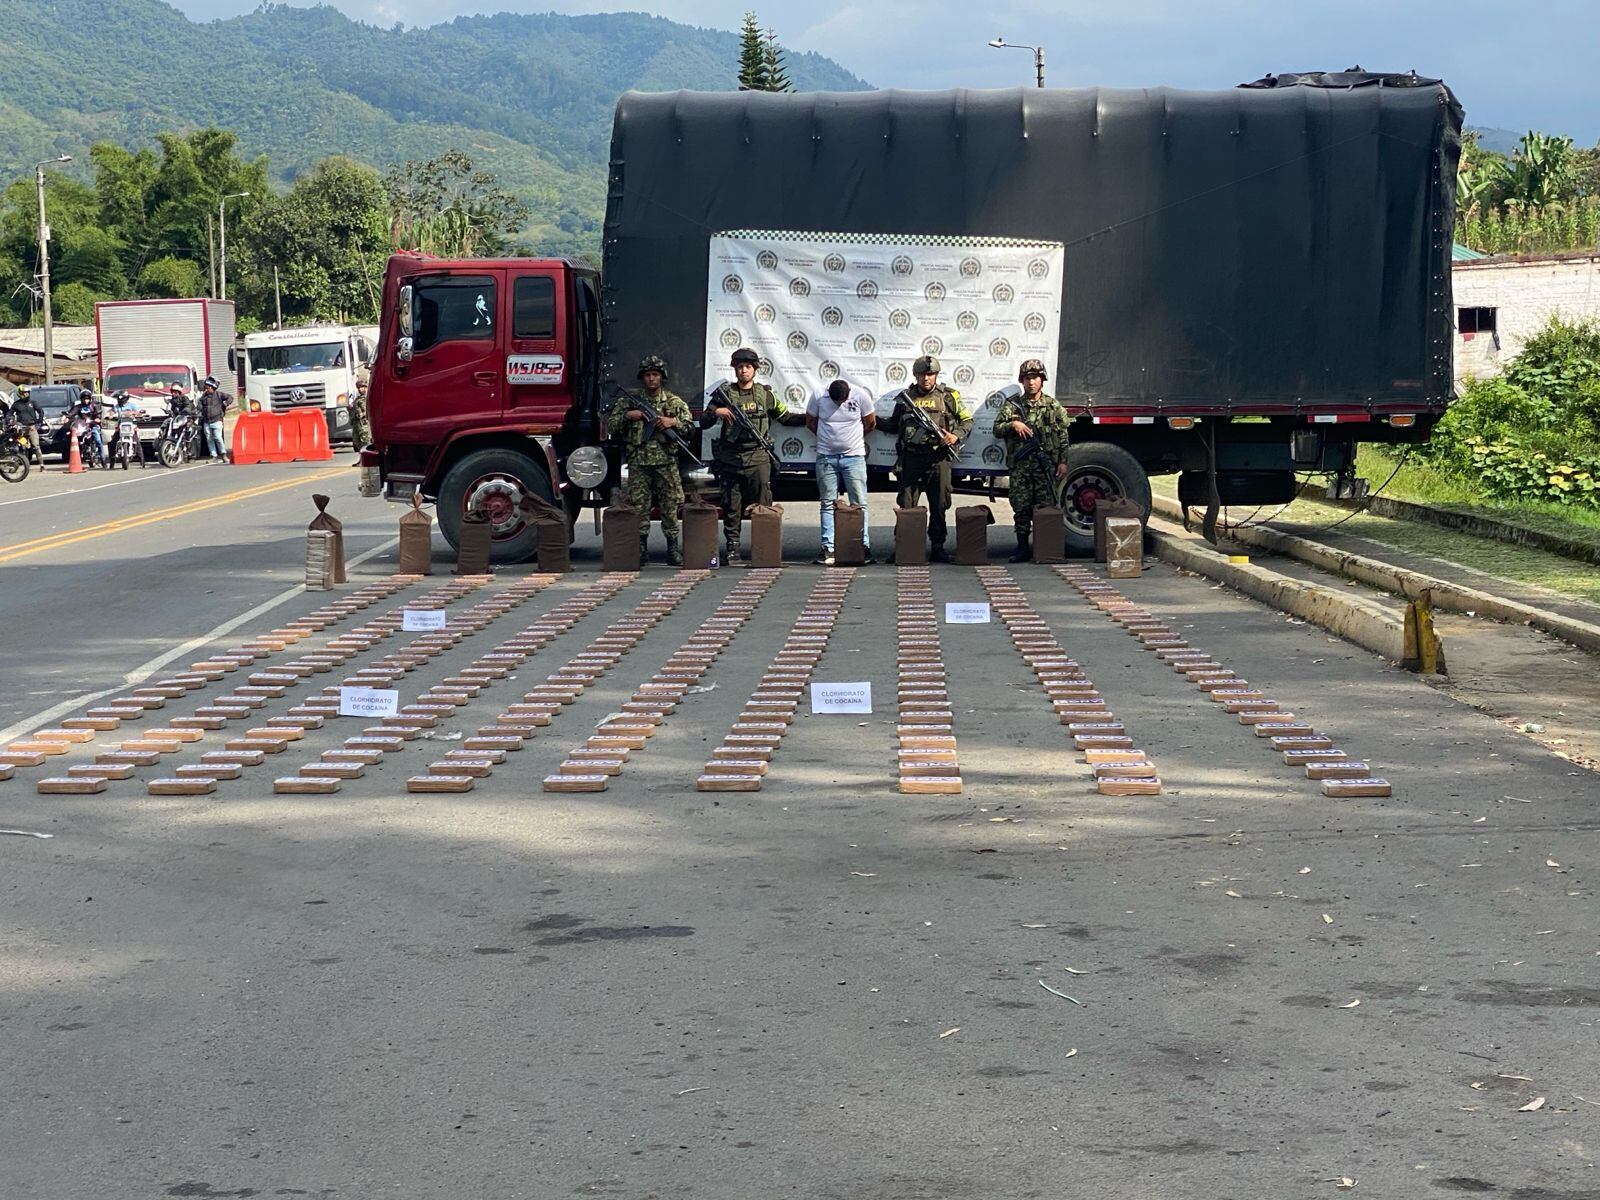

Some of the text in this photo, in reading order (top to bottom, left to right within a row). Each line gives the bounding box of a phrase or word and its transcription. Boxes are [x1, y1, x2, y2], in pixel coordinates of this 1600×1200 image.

[508, 362, 563, 375] WSJ852
[914, 399, 936, 408] OLICIA
[350, 696, 392, 704] CLORHIDRATO
